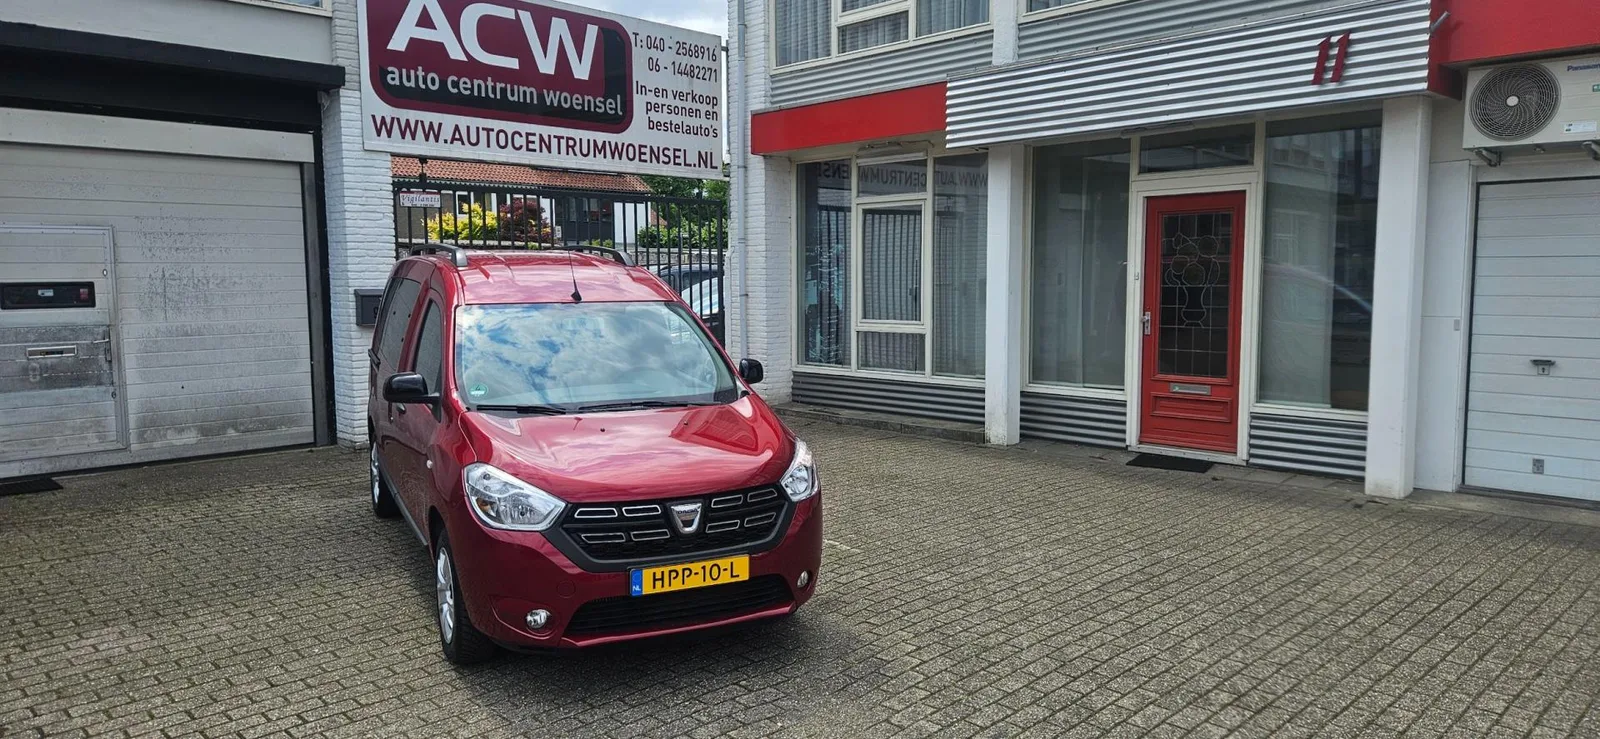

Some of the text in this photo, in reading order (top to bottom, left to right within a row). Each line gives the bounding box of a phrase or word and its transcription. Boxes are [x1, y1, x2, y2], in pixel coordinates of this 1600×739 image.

[386, 0, 599, 80] ACW
[632, 32, 643, 48] T:
[646, 35, 665, 52] 040
[675, 41, 717, 62] 2568916
[647, 57, 660, 73] 06
[671, 61, 718, 83] 14482271
[1311, 32, 1350, 85] 11
[386, 65, 623, 116] auto centrum woensel
[635, 80, 718, 109] In-en verkoop
[646, 101, 718, 121] personen en
[648, 116, 718, 138] bestelauto's
[371, 114, 718, 170] WWW.AUTOCENTRUMWOENSEL.NL
[652, 562, 740, 589] HPP-10-L
